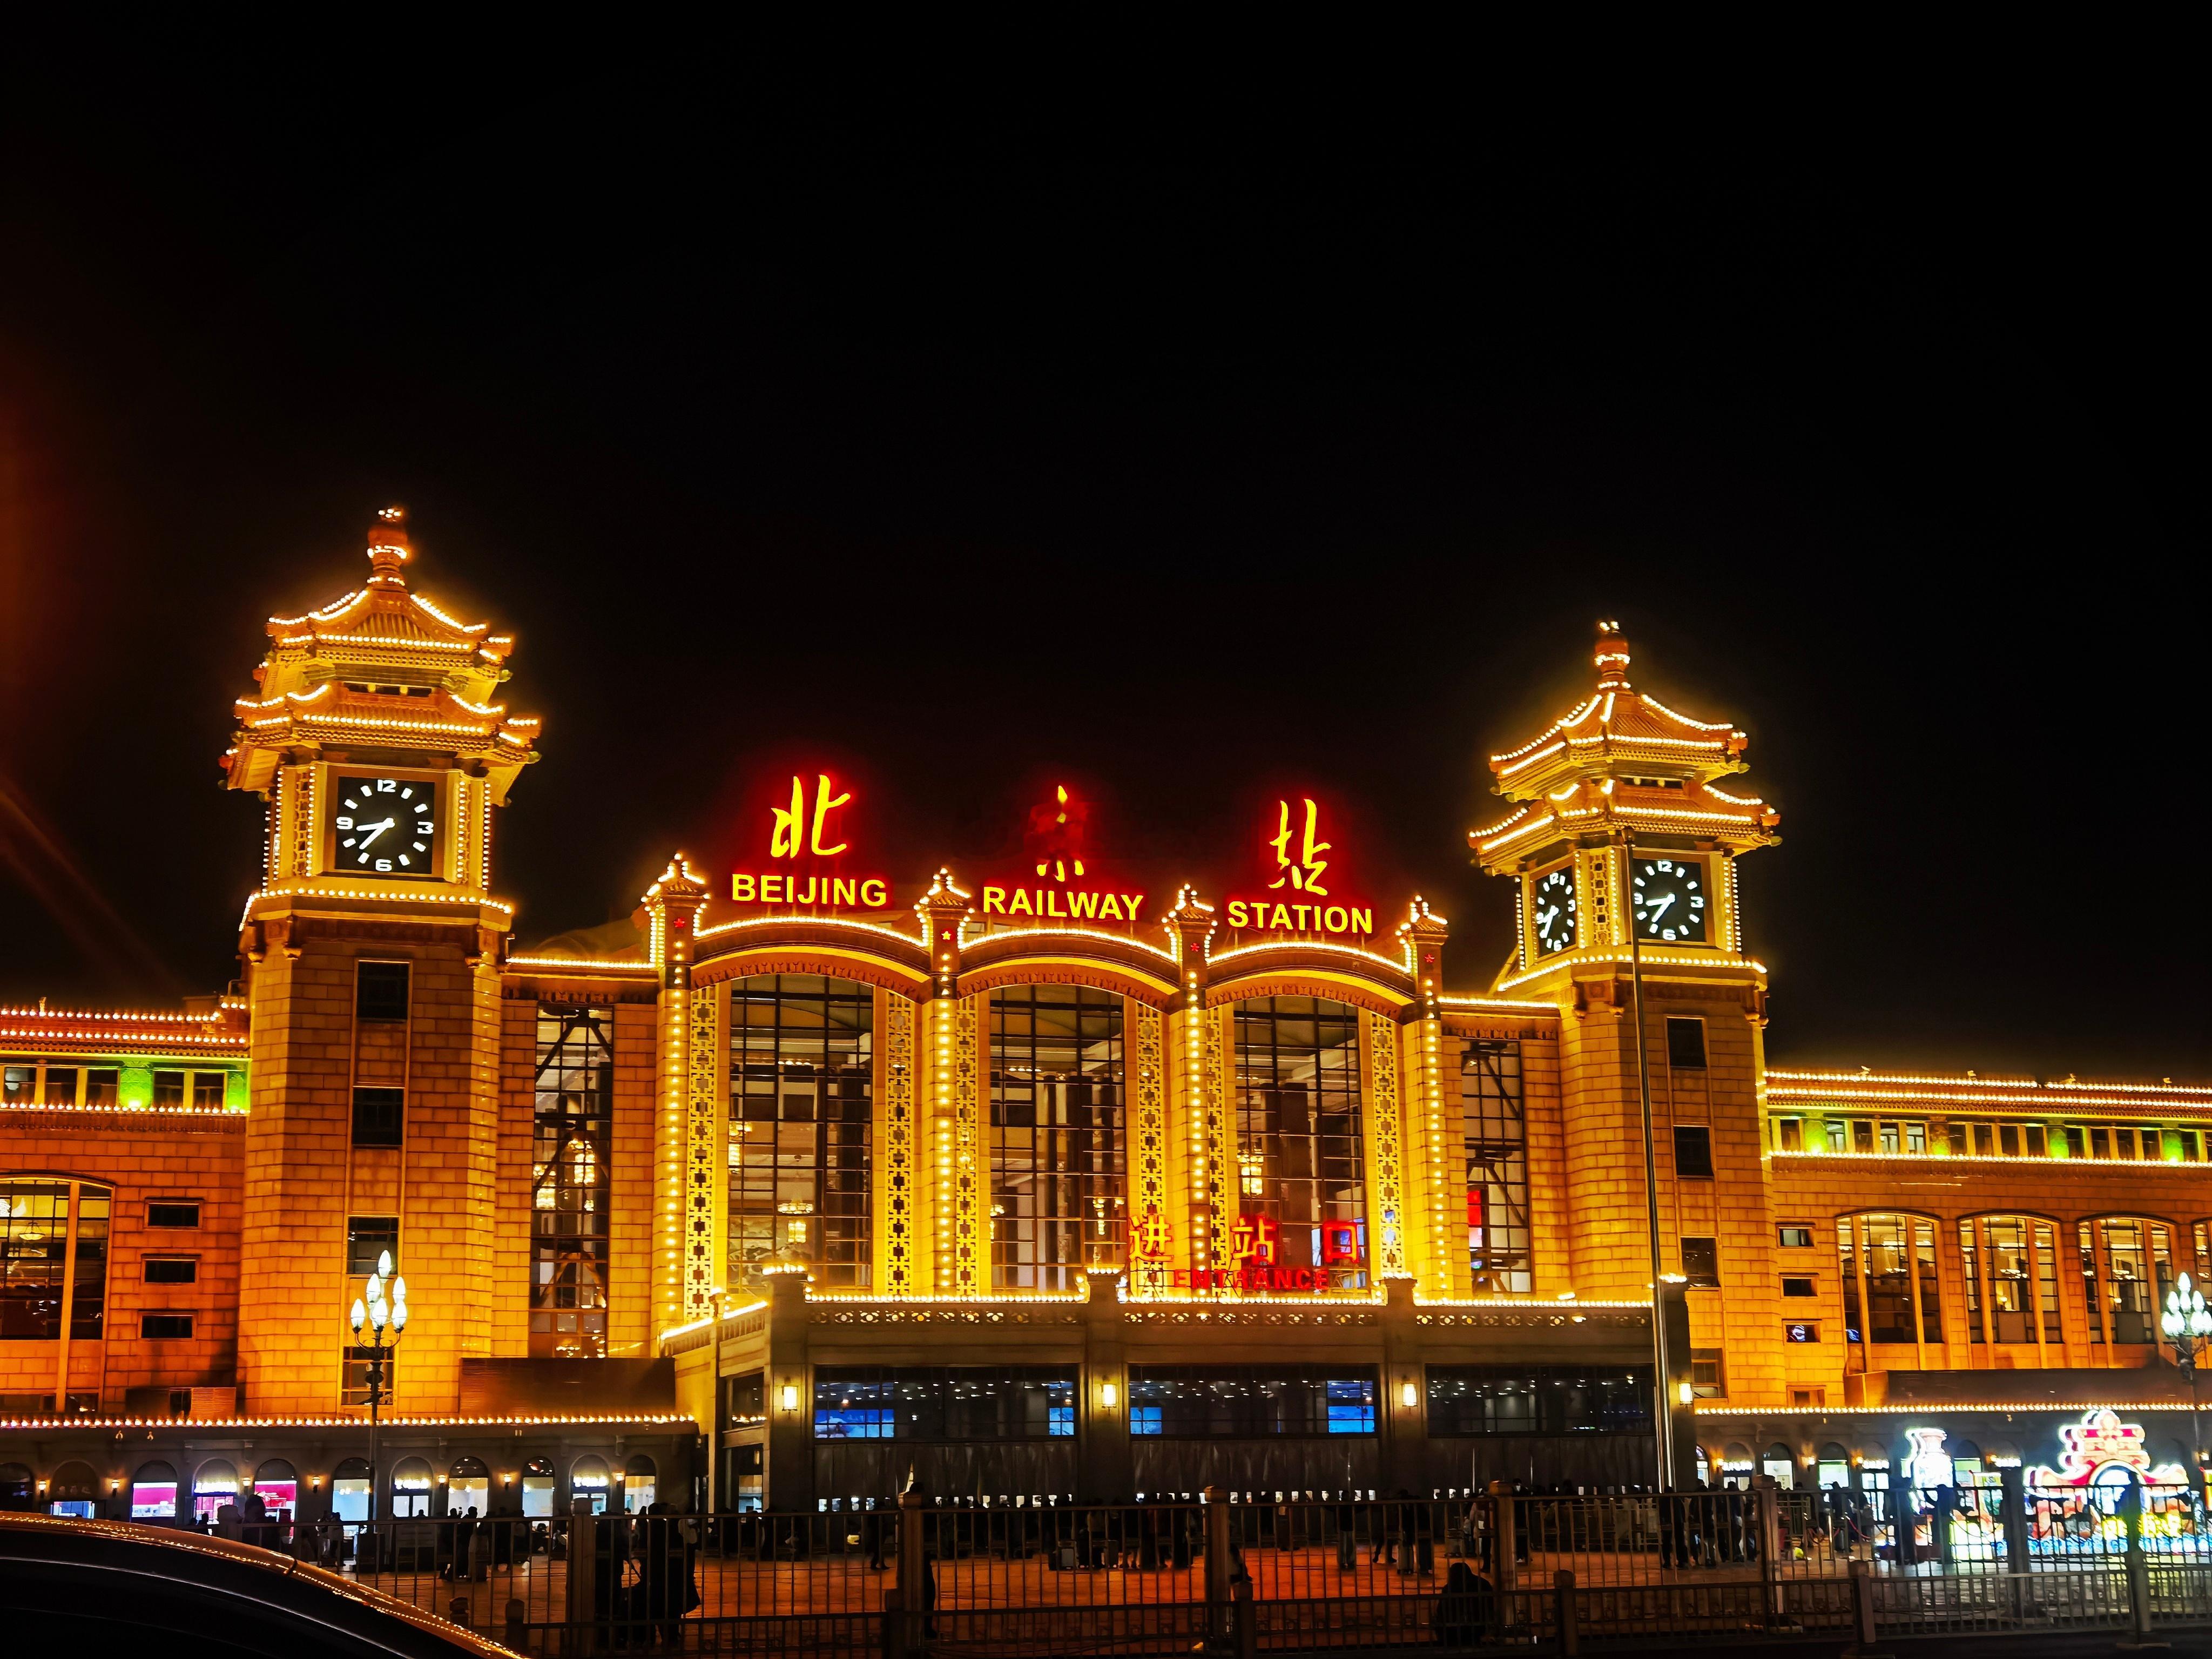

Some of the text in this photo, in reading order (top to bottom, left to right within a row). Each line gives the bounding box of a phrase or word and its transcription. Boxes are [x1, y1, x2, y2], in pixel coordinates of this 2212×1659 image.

[377, 779, 396, 792] 12
[336, 817, 353, 830] 9
[417, 821, 434, 834] 3
[375, 859, 392, 871] 6
[1657, 861, 1673, 872] 12
[1549, 872, 1559, 885] 12
[732, 873, 1372, 933] BEIJING RAILWAY STATION
[1568, 899, 1576, 912] 3
[1690, 896, 1704, 908] 3
[1663, 929, 1676, 940] 6
[1554, 940, 1562, 952] 6
[1129, 1215, 1360, 1264] 进站口
[1174, 1269, 1328, 1289] ENTRANCE
